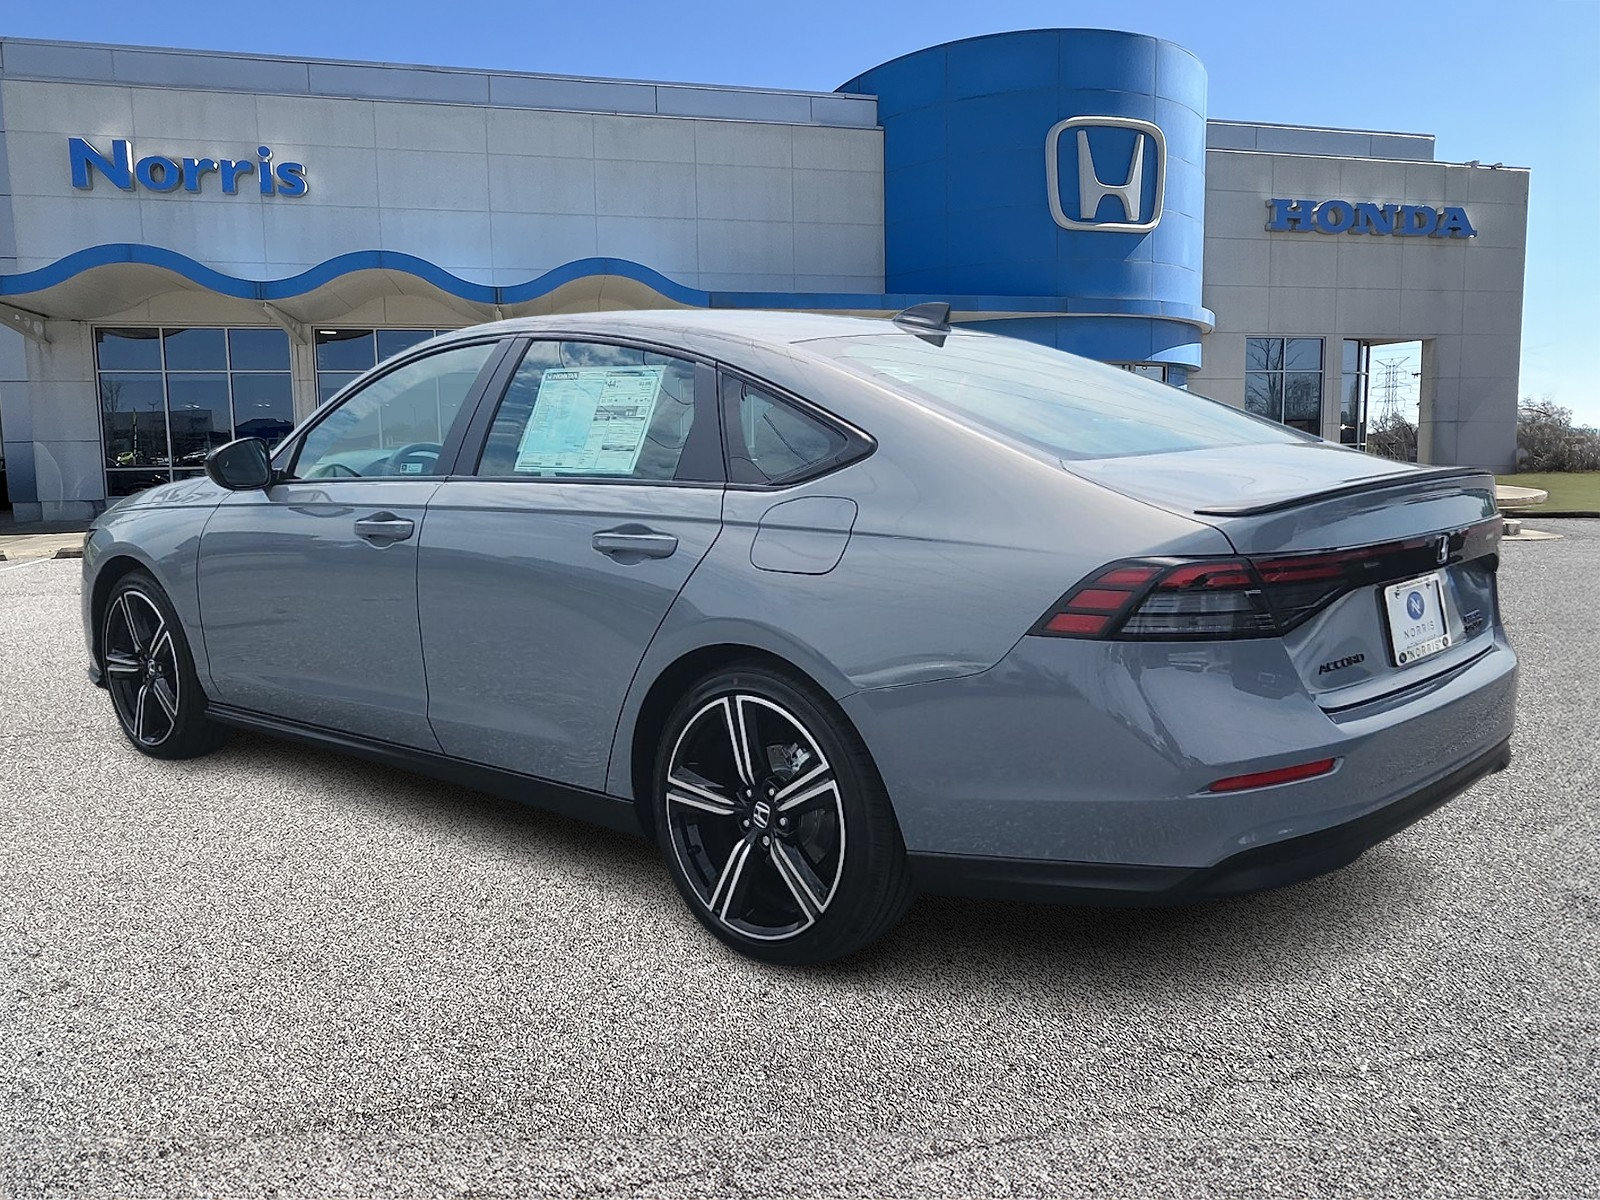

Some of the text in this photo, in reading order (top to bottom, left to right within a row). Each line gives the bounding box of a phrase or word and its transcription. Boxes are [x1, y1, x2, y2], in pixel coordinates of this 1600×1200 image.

[68, 137, 309, 197] Norris
[1265, 198, 1477, 239] HONDA
[1404, 620, 1435, 639] NORRIS
[1318, 653, 1364, 675] ACCORD
